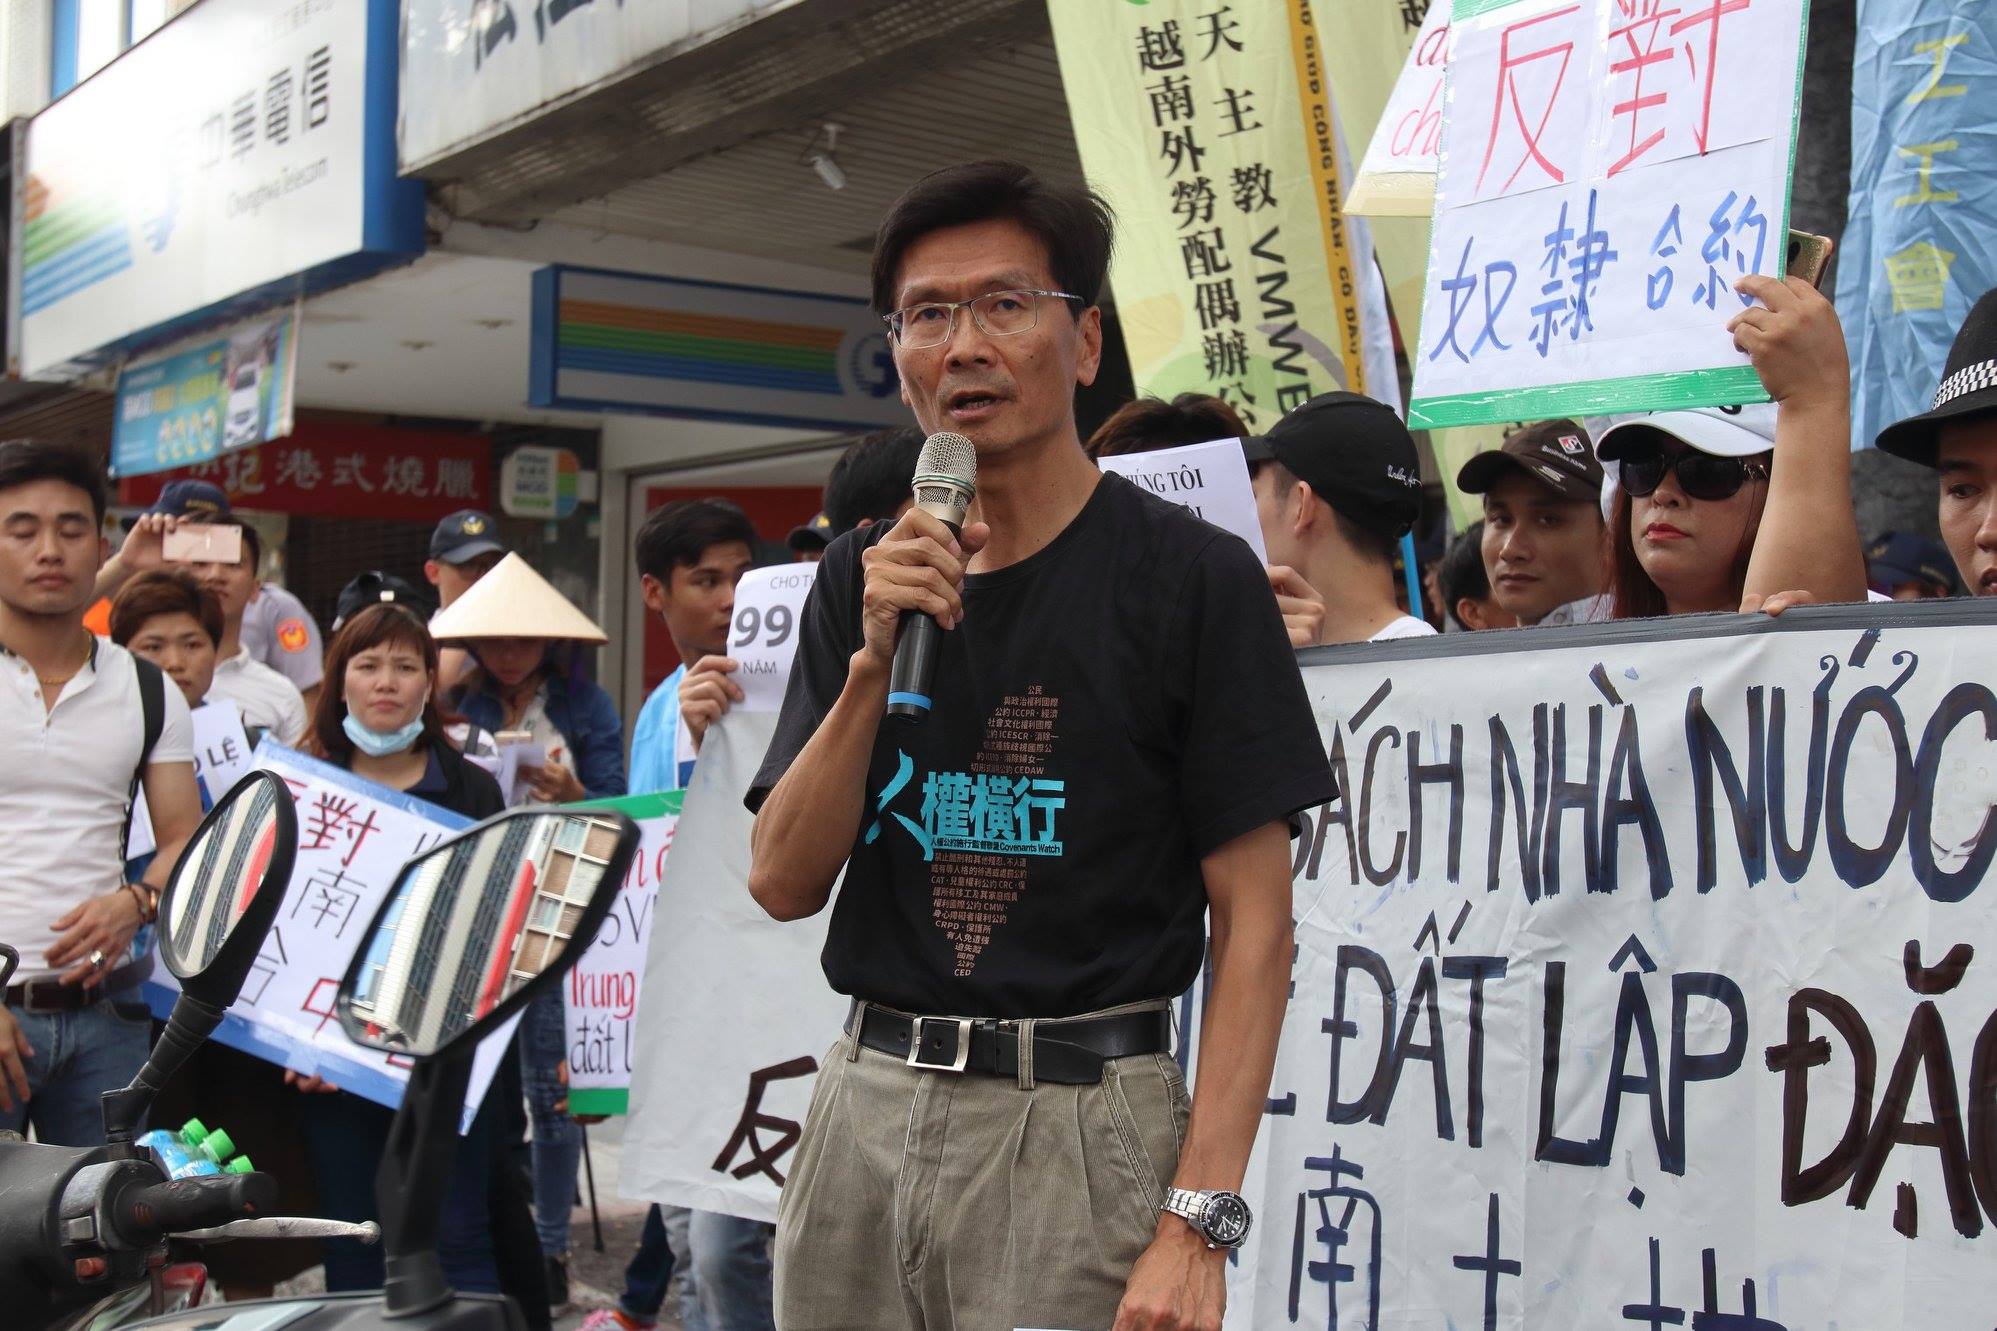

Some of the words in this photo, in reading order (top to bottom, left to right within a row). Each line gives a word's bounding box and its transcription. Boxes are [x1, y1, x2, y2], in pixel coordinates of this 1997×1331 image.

[1474, 0, 1750, 198] 反對
[1429, 188, 1768, 364] 奴隸合約
[1167, 464, 1204, 491] TÔI
[770, 575, 799, 590] CHO
[734, 604, 793, 648] 99
[743, 659, 777, 674] NĂM
[865, 748, 1066, 862] 人權橫行
[1487, 662, 1674, 905] NHÀ
[1000, 842, 1037, 853] Covenants
[1038, 843, 1061, 854] Watch
[954, 968, 972, 977] CED
[1321, 900, 1509, 1149] ĐẤT
[1535, 933, 1749, 1211] LẬP
